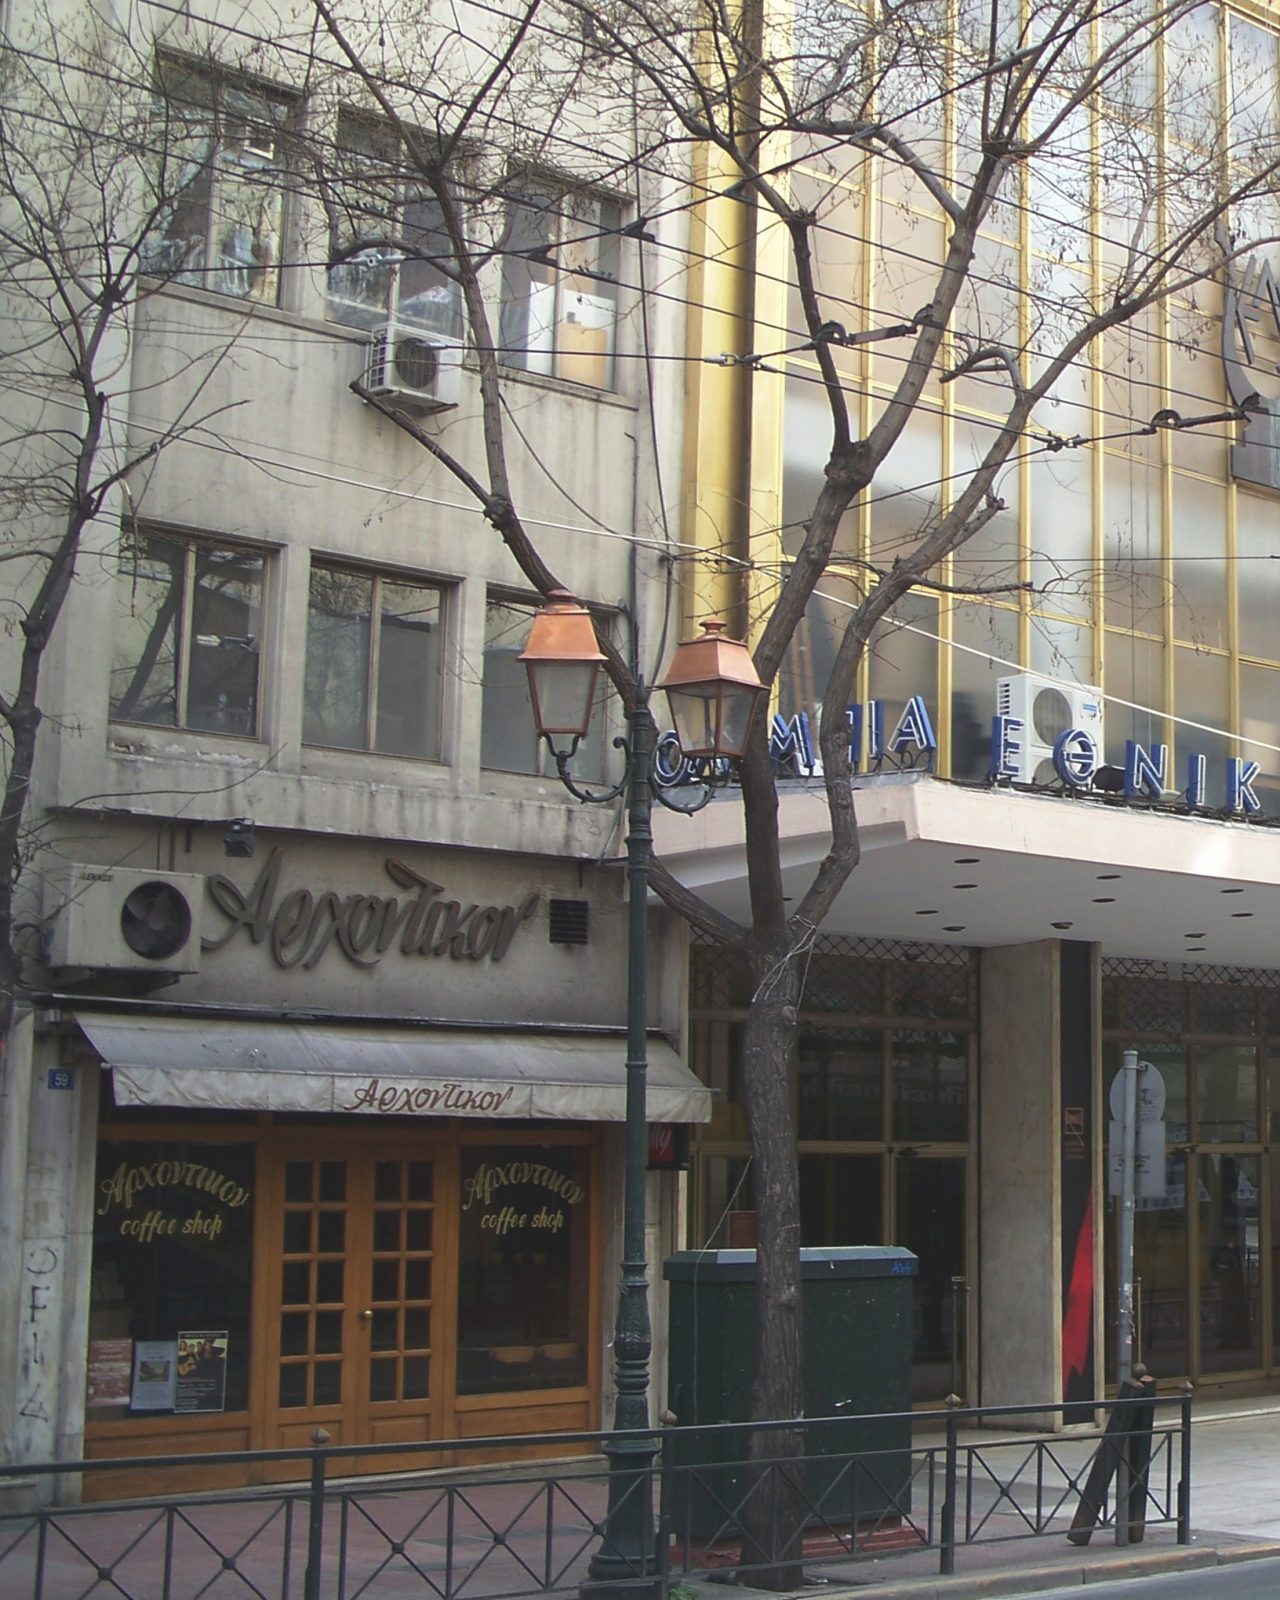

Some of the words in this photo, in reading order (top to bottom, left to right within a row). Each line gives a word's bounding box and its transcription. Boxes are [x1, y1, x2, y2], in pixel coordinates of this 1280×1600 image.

[54, 1072, 69, 1087] 59
[120, 1210, 177, 1242] coffee
[182, 1210, 223, 1240] shop
[481, 1206, 527, 1235] coffee
[531, 1206, 564, 1233] shop
